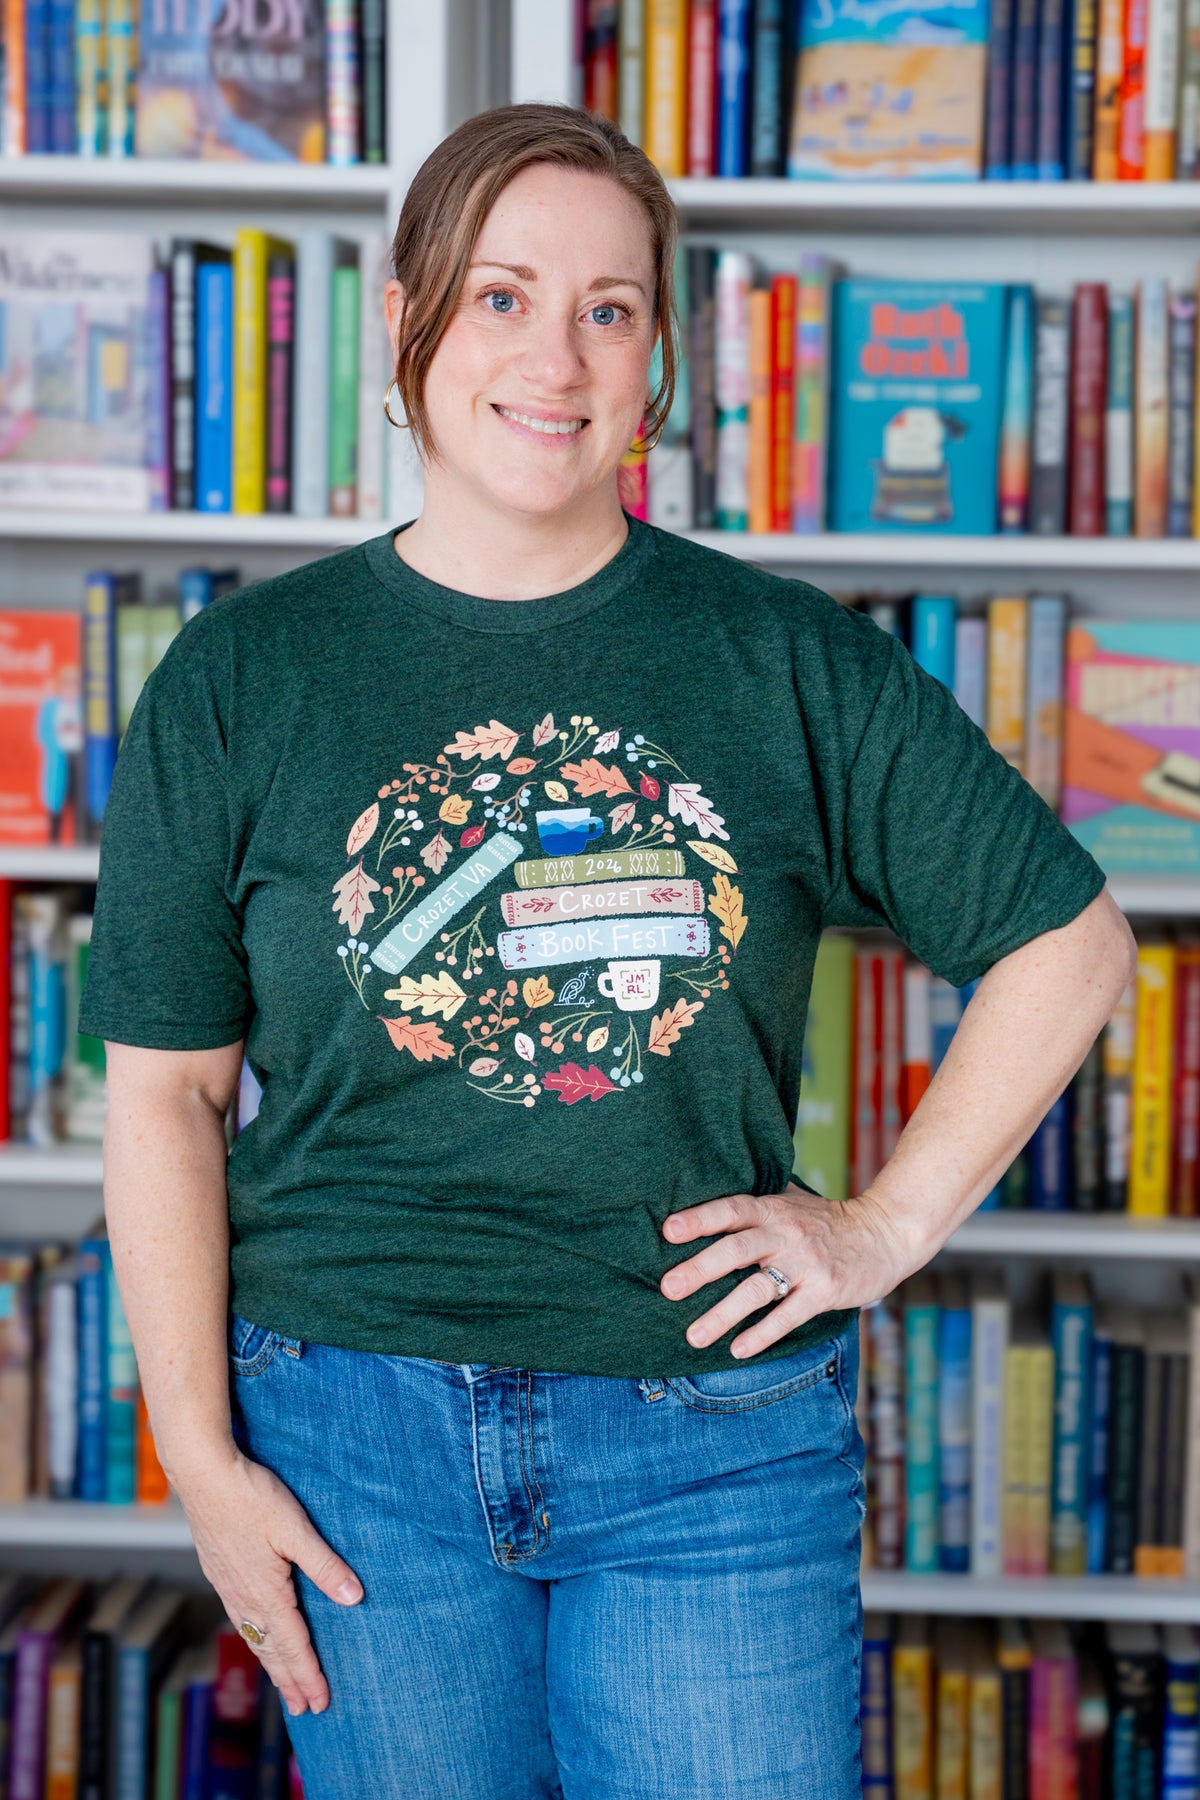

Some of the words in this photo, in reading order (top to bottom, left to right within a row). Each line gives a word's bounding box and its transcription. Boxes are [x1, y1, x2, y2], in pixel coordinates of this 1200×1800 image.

[585, 858, 622, 876] 2026
[402, 881, 471, 942] CROZET,
[460, 863, 492, 884] VA
[558, 887, 648, 913] CROZET
[537, 927, 605, 958] BOOK
[612, 924, 674, 953] FEST
[626, 973, 645, 983] JM
[627, 984, 645, 994] RL
